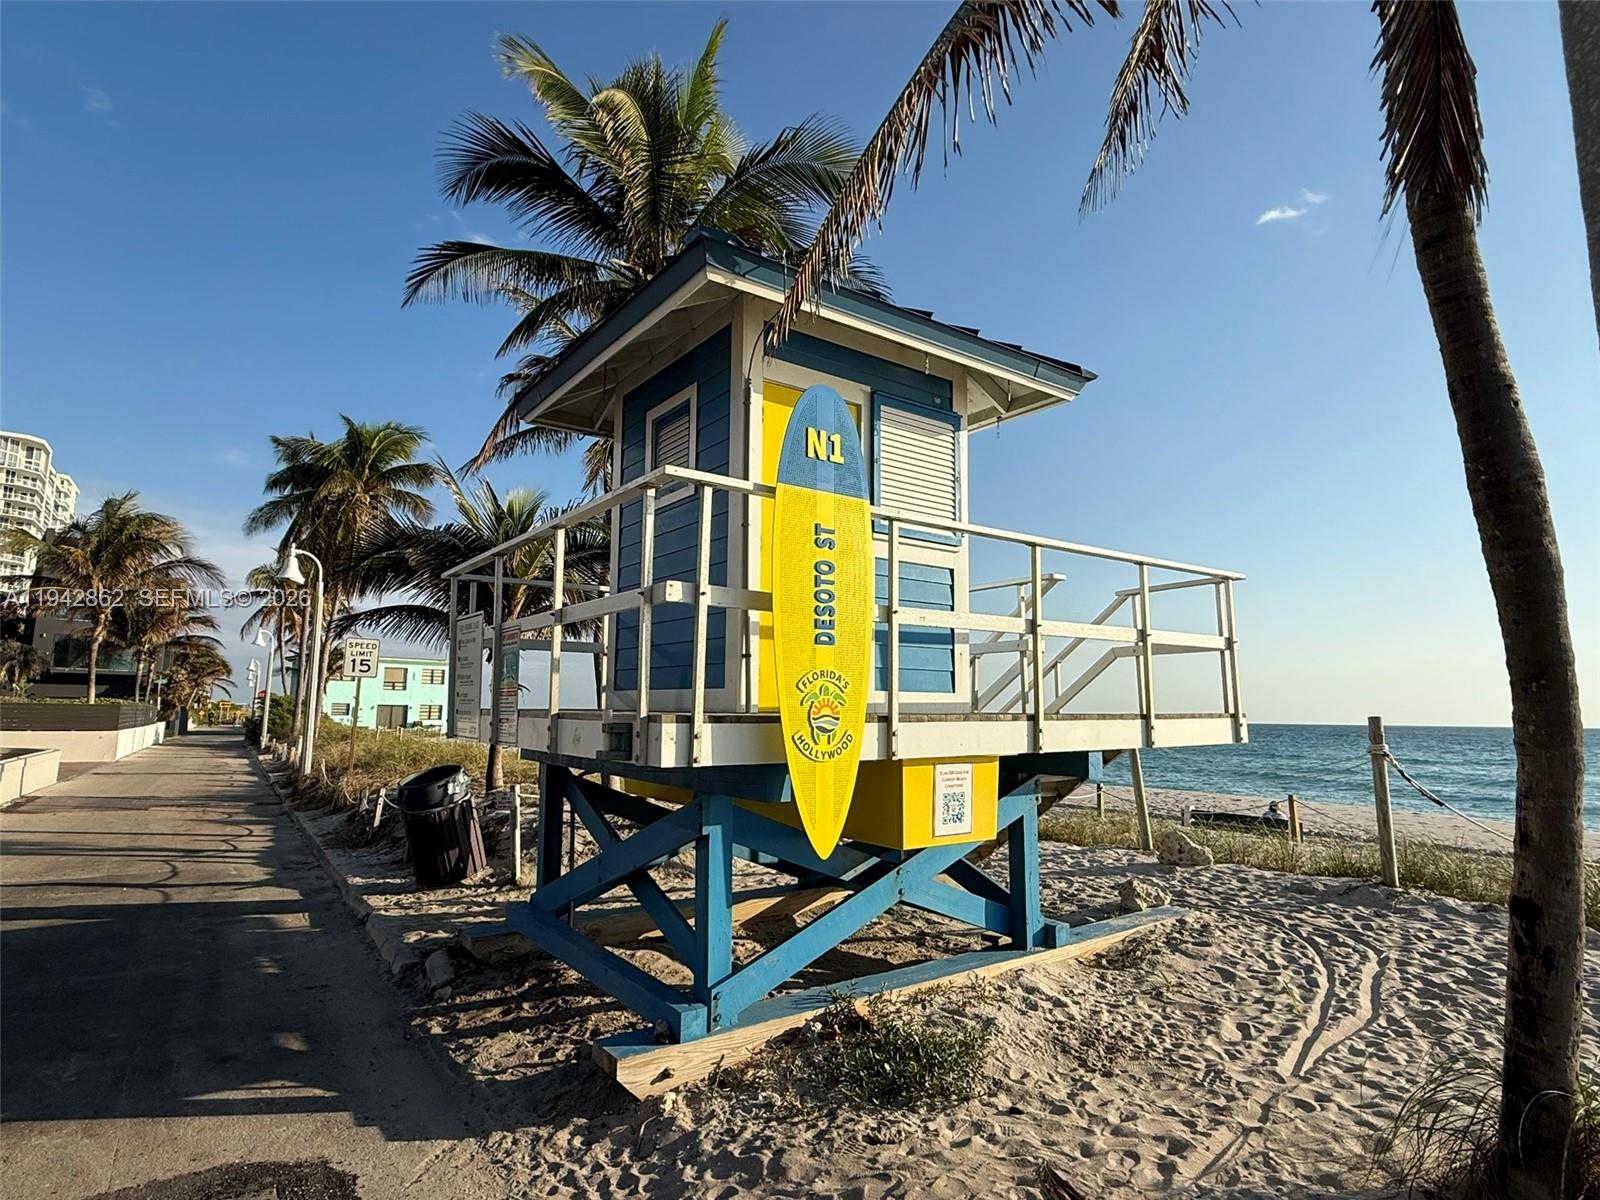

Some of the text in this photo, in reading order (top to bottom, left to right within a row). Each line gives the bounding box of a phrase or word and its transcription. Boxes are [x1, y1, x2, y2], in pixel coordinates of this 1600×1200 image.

[805, 426, 845, 465] N1
[814, 523, 836, 646] DESOTO ST
[348, 641, 378, 650] SPEED
[350, 650, 374, 658] LIMIT
[350, 658, 371, 673] 15
[801, 669, 850, 690] FLORIDA'S
[796, 733, 854, 760] HOLLYWOOD
